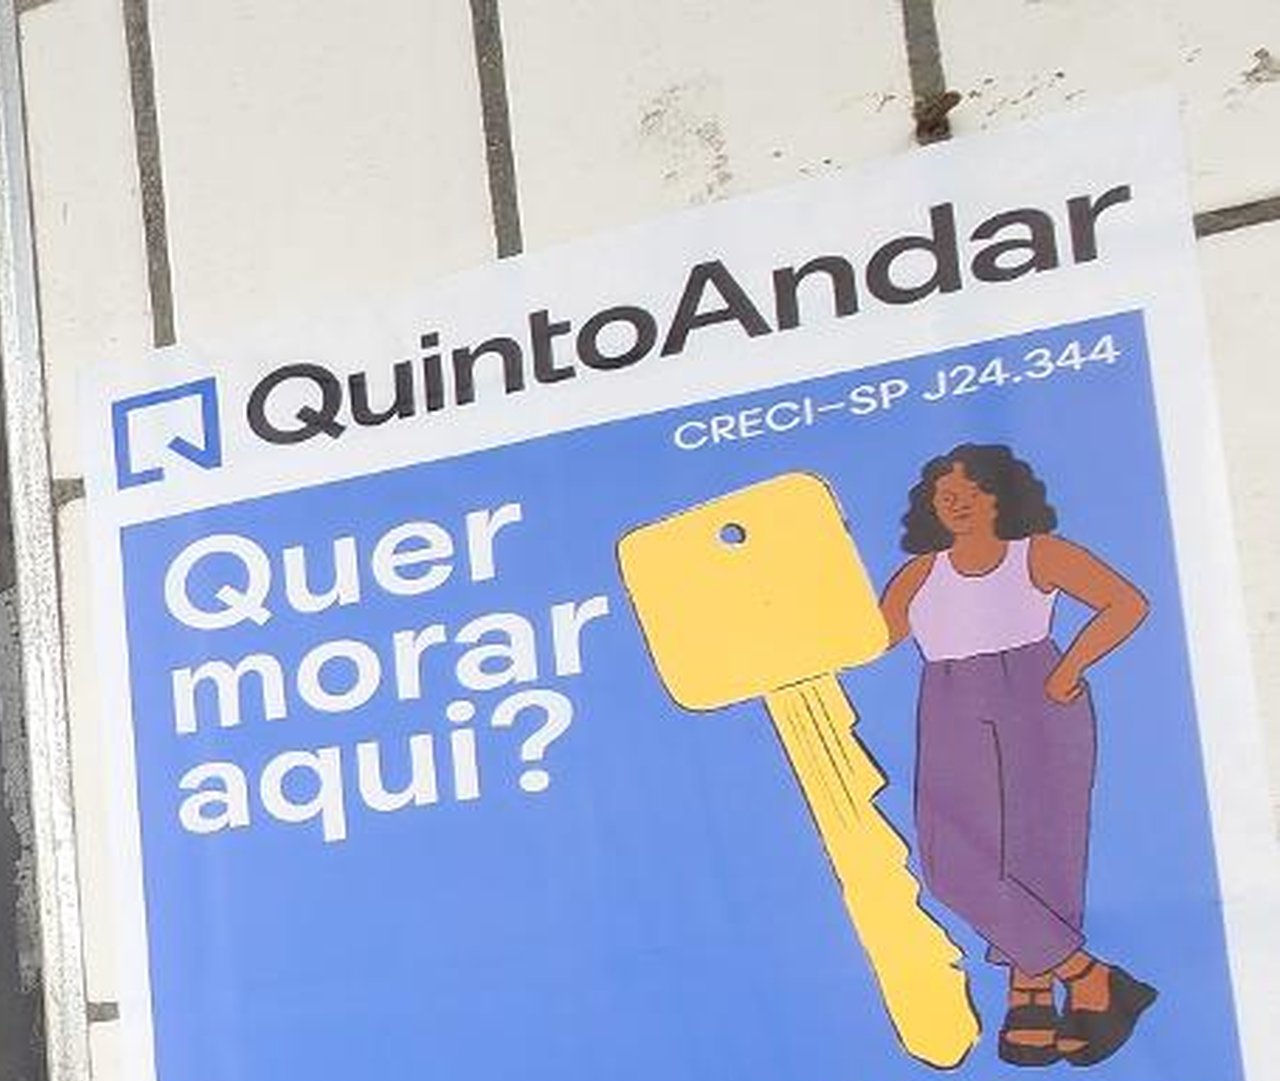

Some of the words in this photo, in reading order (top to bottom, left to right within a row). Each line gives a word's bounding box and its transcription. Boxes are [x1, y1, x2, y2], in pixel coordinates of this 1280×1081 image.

[245, 183, 1132, 444] QuintoAndar
[672, 378, 910, 451] CRECI-SP
[921, 333, 1122, 402] J24.344
[164, 502, 522, 631] Quer
[171, 596, 610, 735] morar
[177, 688, 575, 843] aqui?
